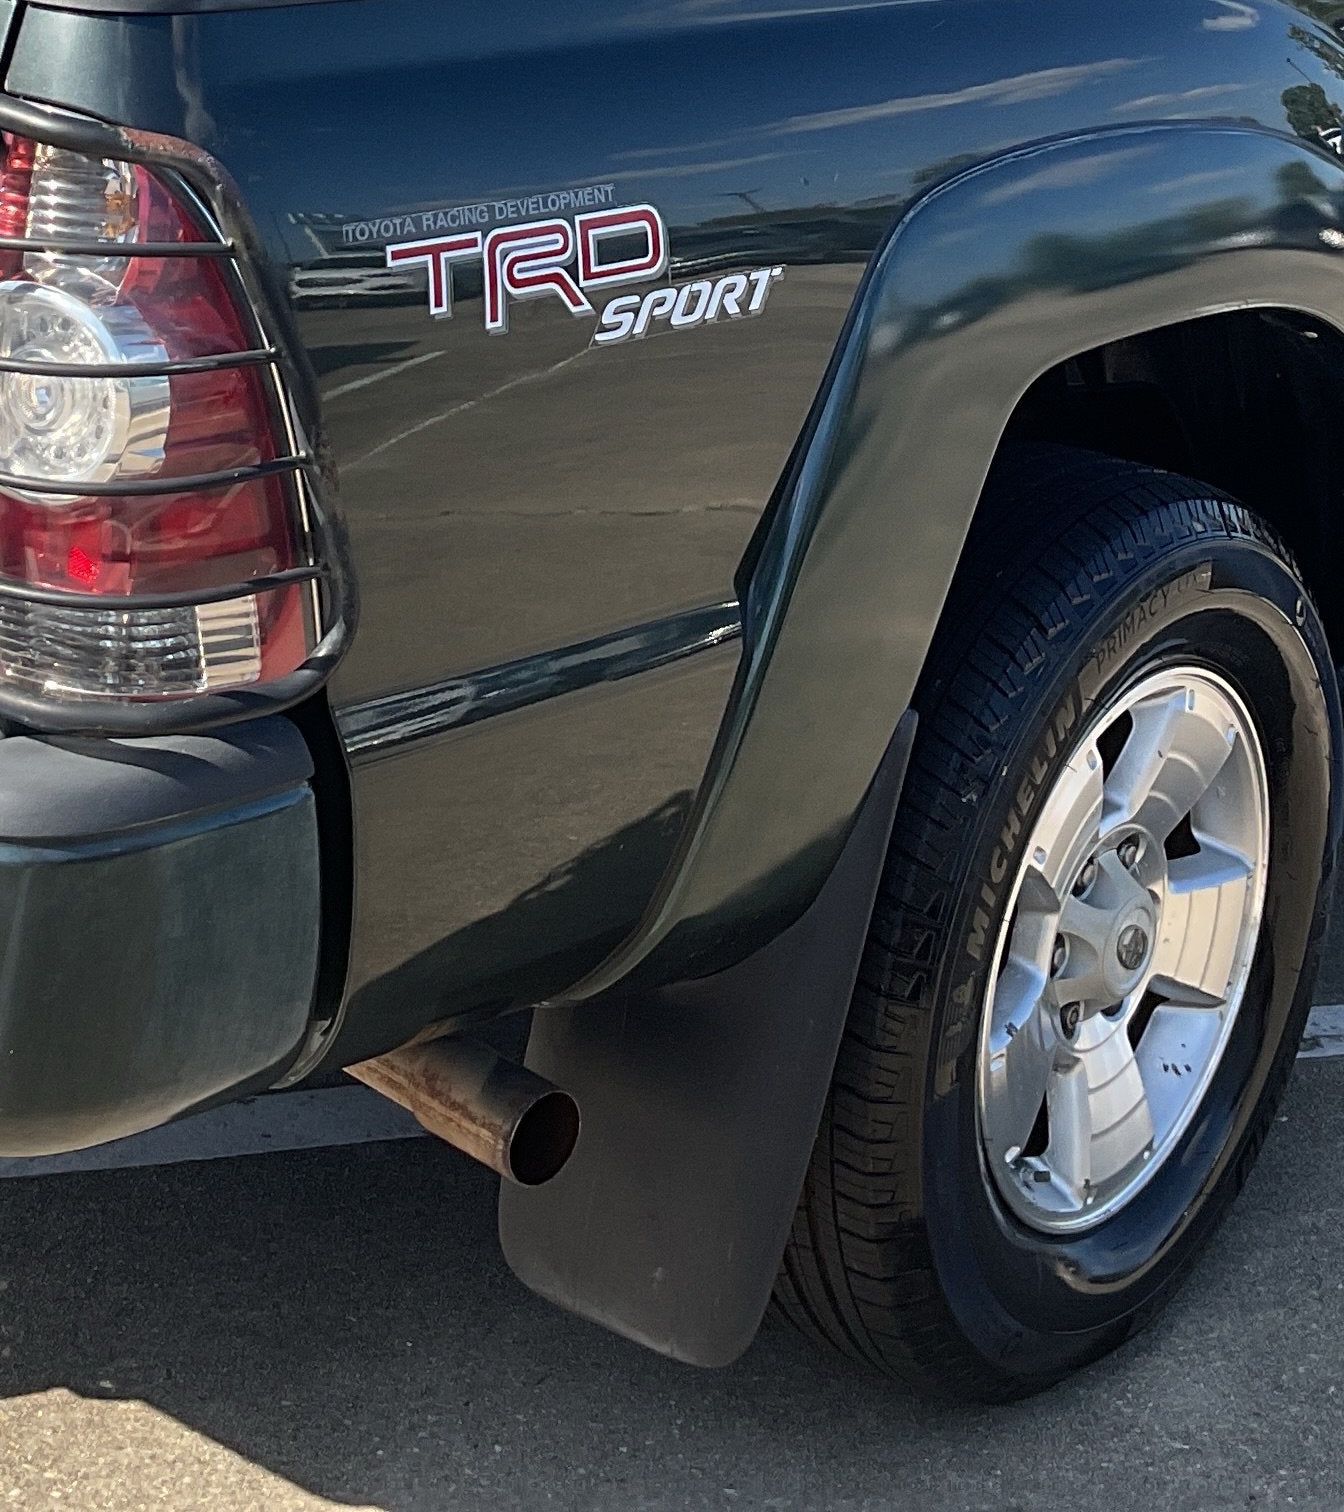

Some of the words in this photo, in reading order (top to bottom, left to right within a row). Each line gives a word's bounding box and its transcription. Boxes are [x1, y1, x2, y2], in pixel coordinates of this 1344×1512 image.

[343, 218, 416, 244] TOYOTA
[422, 204, 490, 233] RACING
[494, 185, 615, 220] DEVELOPMENT
[386, 204, 668, 333] TRD
[595, 266, 786, 345] SPORT
[1092, 585, 1170, 674] PRIMACY
[966, 691, 1077, 961] MICHELIN
